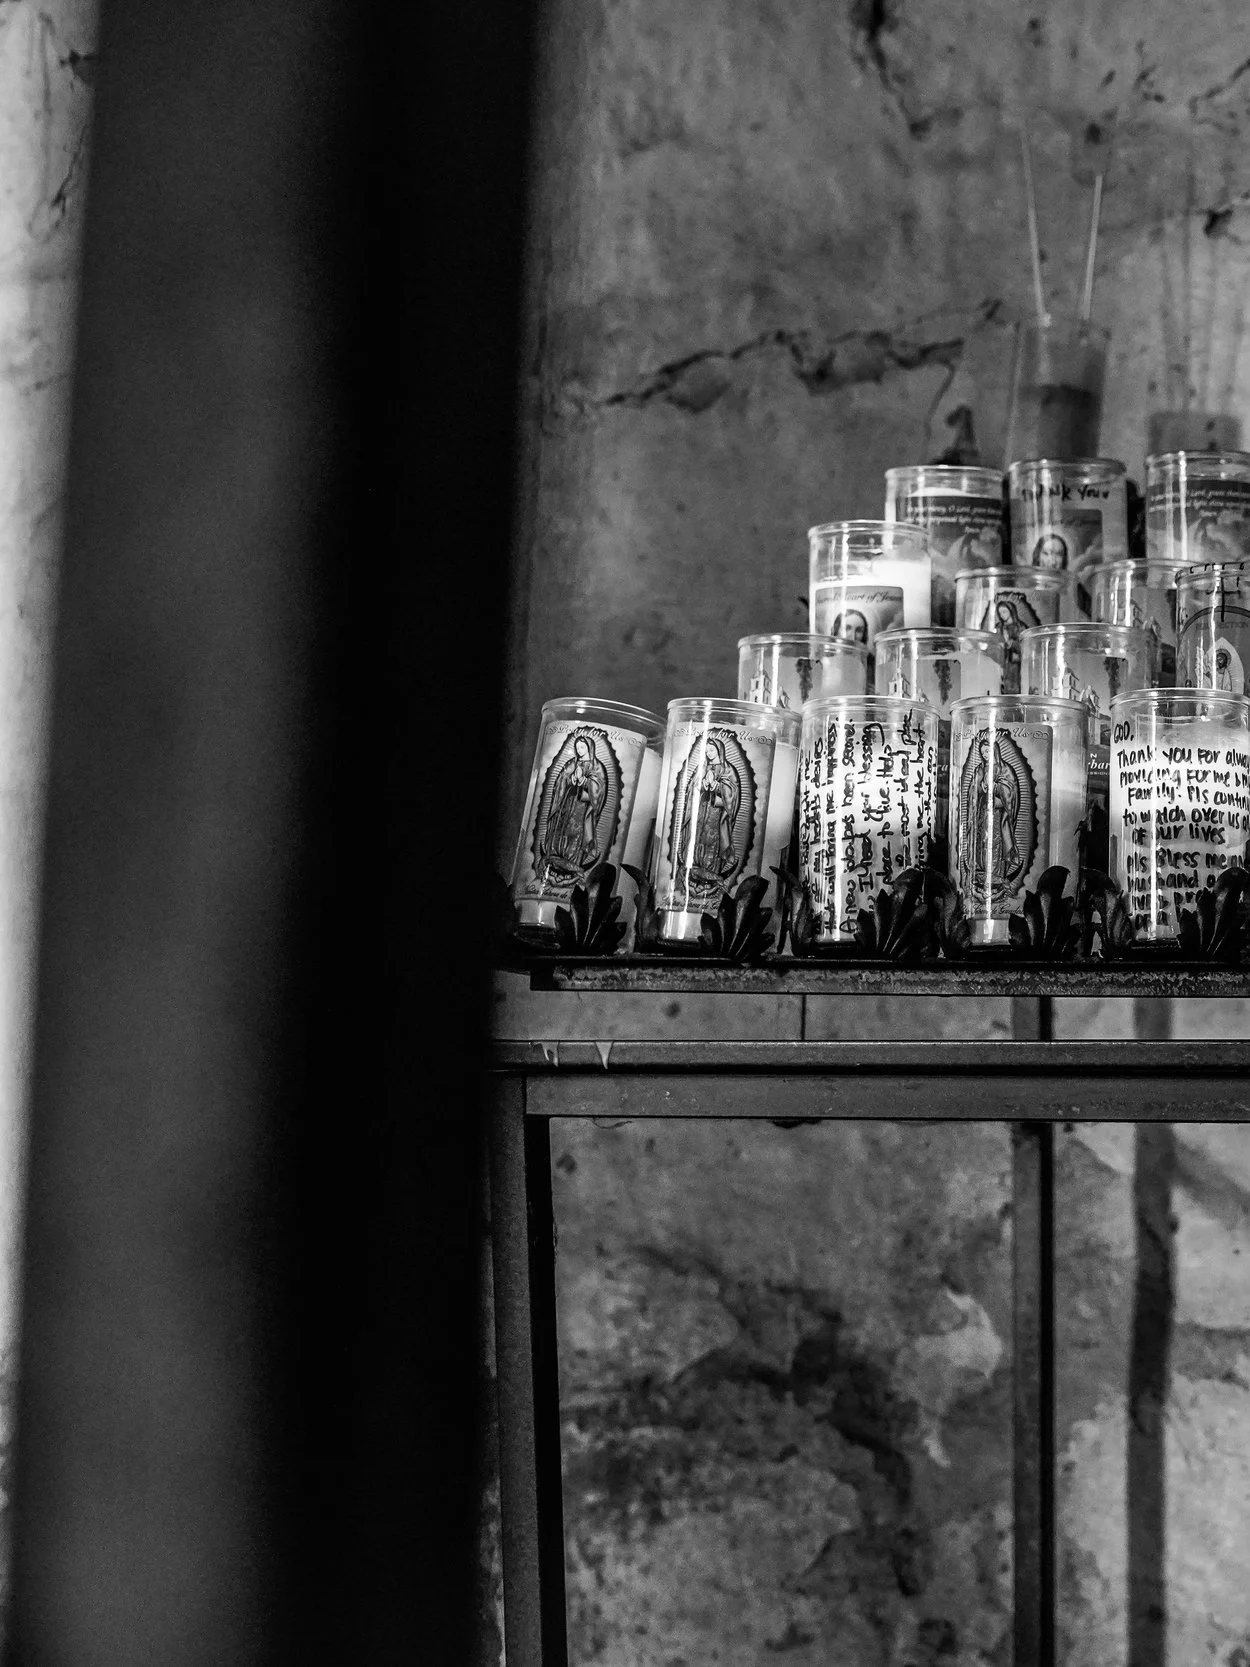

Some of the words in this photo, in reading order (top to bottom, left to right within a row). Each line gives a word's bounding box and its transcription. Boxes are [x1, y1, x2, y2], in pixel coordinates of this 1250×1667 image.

[588, 726, 607, 738] for
[610, 730, 624, 742] Us
[716, 727, 736, 738] for
[740, 731, 753, 743] Us
[1012, 728, 1028, 738] Us
[1117, 745, 1154, 768] Thank
[914, 767, 924, 798] the
[1213, 770, 1230, 788] me
[1187, 786, 1210, 805] Pls
[916, 798, 924, 828] me
[1123, 808, 1138, 827] to
[1140, 805, 1187, 826] watch
[1228, 811, 1240, 830] us
[877, 822, 894, 839] to
[1188, 823, 1226, 845] lives
[876, 841, 894, 886] place
[1206, 853, 1228, 870] me
[824, 866, 836, 895] will
[844, 880, 857, 914] new
[824, 899, 836, 934] that
[839, 916, 856, 934] A
